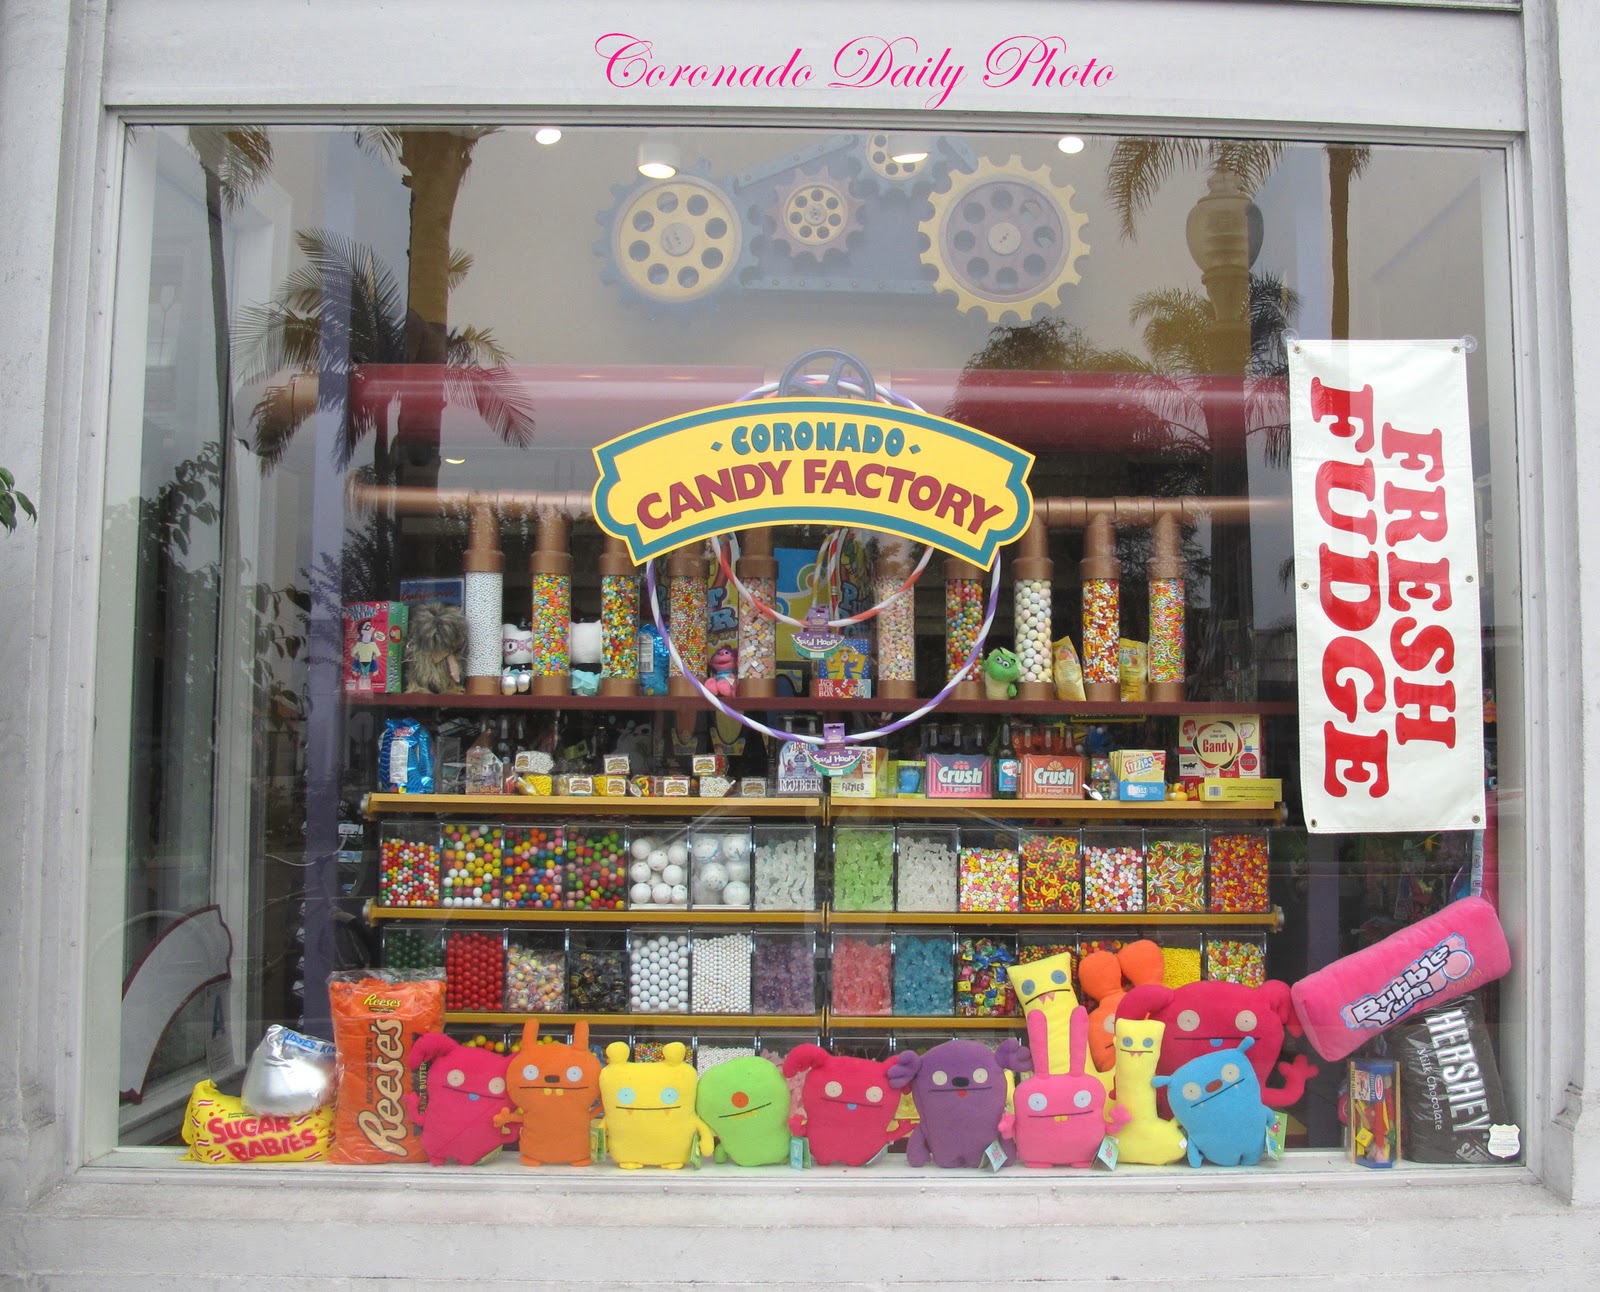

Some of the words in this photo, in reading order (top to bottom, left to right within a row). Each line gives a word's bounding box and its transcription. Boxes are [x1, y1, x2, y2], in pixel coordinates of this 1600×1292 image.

[731, 421, 905, 456] CORONADO
[636, 459, 792, 530] CANDY
[803, 459, 1004, 535] FACTORY
[1310, 376, 1390, 799] FUDGE
[1381, 422, 1456, 749] FRESH
[818, 679, 834, 687] JACK
[1203, 739, 1233, 756] Candy
[842, 783, 864, 792] FIZZIES
[938, 766, 982, 784] Crush
[1034, 767, 1075, 785] Crush
[363, 993, 401, 1008] Reese's
[1352, 945, 1450, 1023] Bubble
[1362, 981, 1434, 1026] Yum
[365, 1037, 374, 1083] CHOCOLATE
[358, 1019, 408, 1157] Reese's
[366, 1085, 374, 1104] MILK
[1417, 1047, 1433, 1074] Milk
[1426, 1075, 1442, 1130] Chocolate
[207, 1116, 293, 1144] SUGAR
[226, 1129, 318, 1161] BABIES
